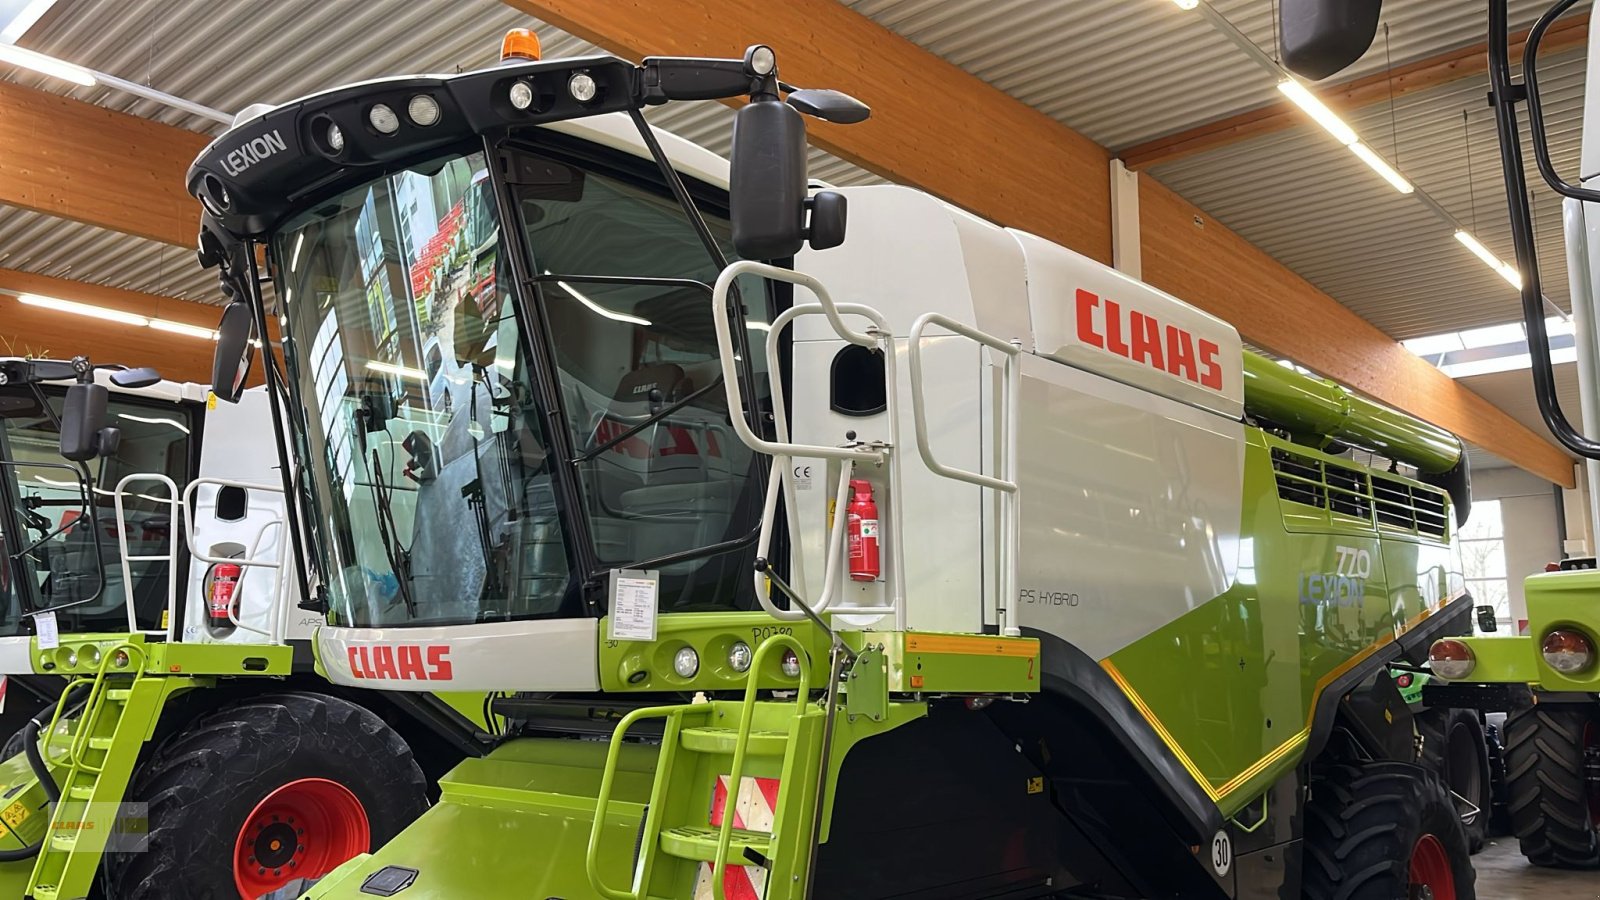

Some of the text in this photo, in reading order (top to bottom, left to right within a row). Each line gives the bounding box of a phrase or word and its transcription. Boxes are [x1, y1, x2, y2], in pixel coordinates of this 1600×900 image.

[220, 129, 287, 177] LEXION
[1076, 288, 1222, 391] CLAAS
[794, 466, 810, 478] CE
[1336, 545, 1371, 579] 770
[1018, 589, 1079, 607] PS HYBRID
[1298, 572, 1364, 608] LEXION
[347, 645, 453, 681] CLAAS
[1215, 838, 1228, 868] 30
